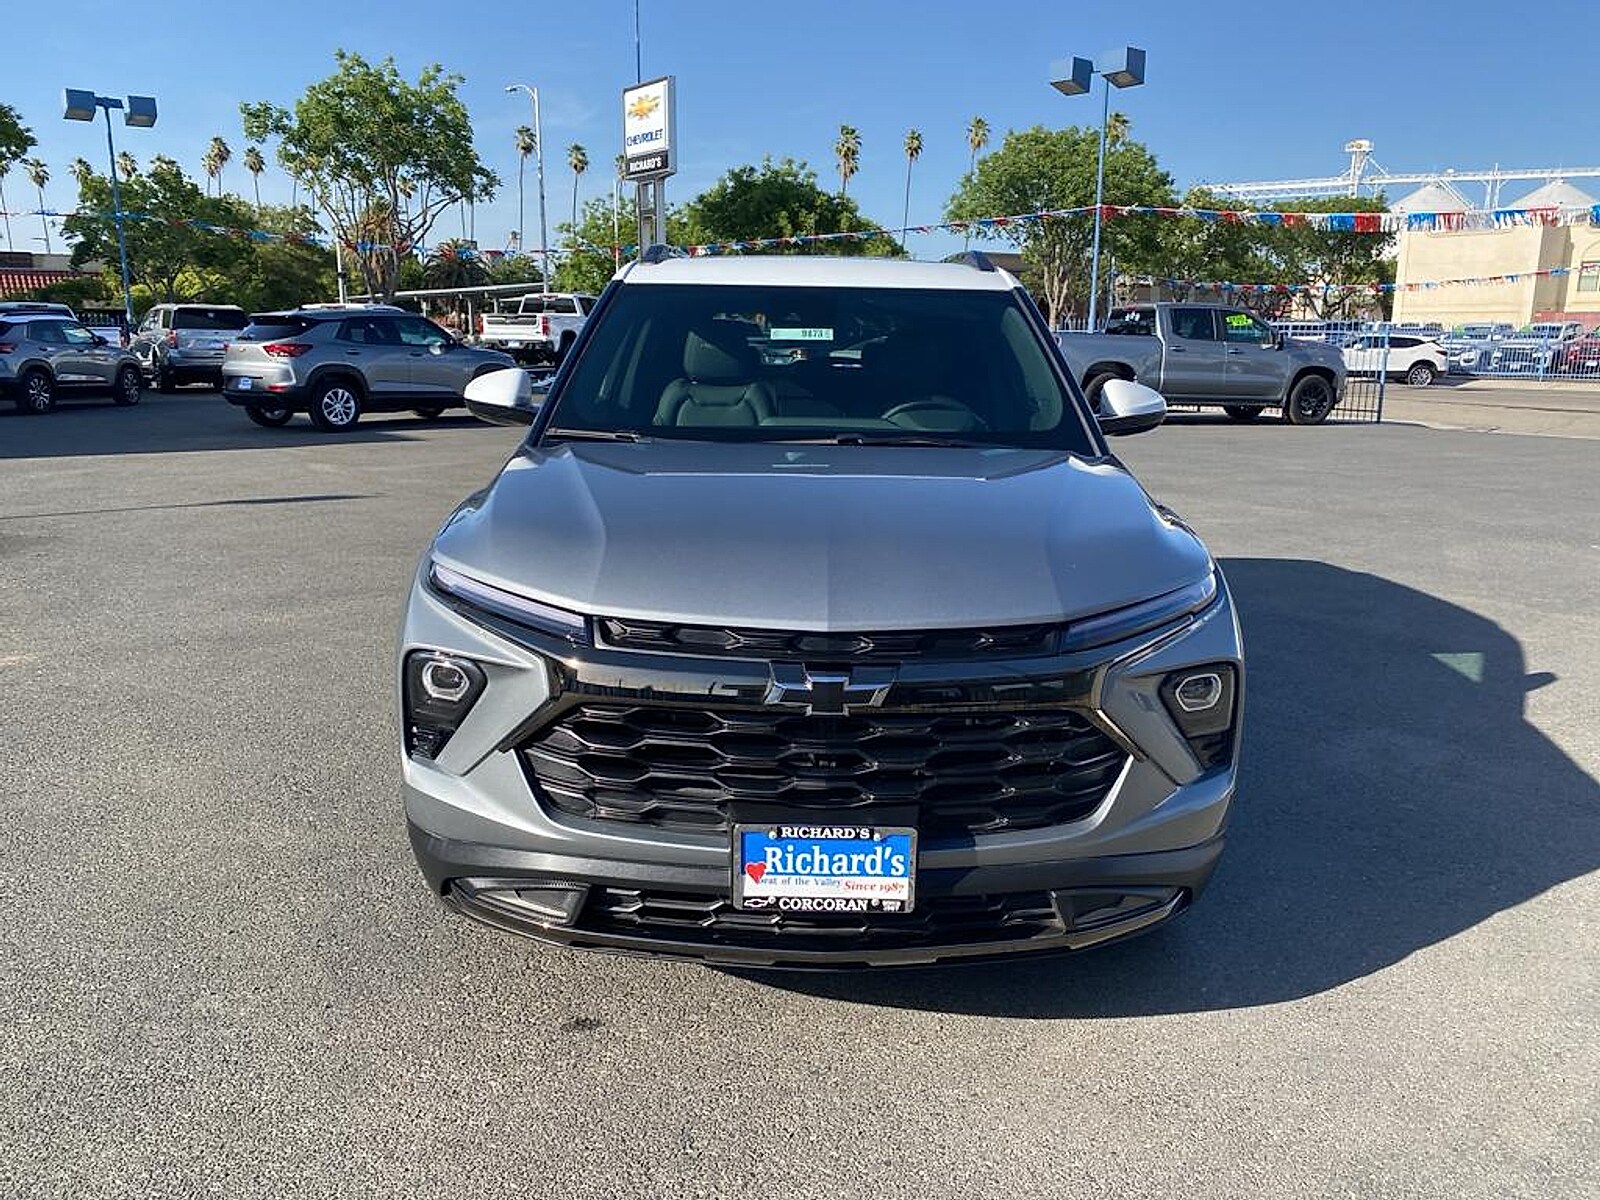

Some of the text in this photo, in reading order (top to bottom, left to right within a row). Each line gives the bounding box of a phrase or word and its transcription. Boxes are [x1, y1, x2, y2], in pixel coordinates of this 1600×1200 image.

[626, 129, 663, 146] CHEVROLET
[781, 827, 870, 839] RICHARD'S
[764, 845, 905, 876] Richard's
[781, 876, 791, 886] of
[795, 877, 810, 886] the
[843, 881, 904, 894] Since 1987
[779, 898, 868, 912] CORCORAN
